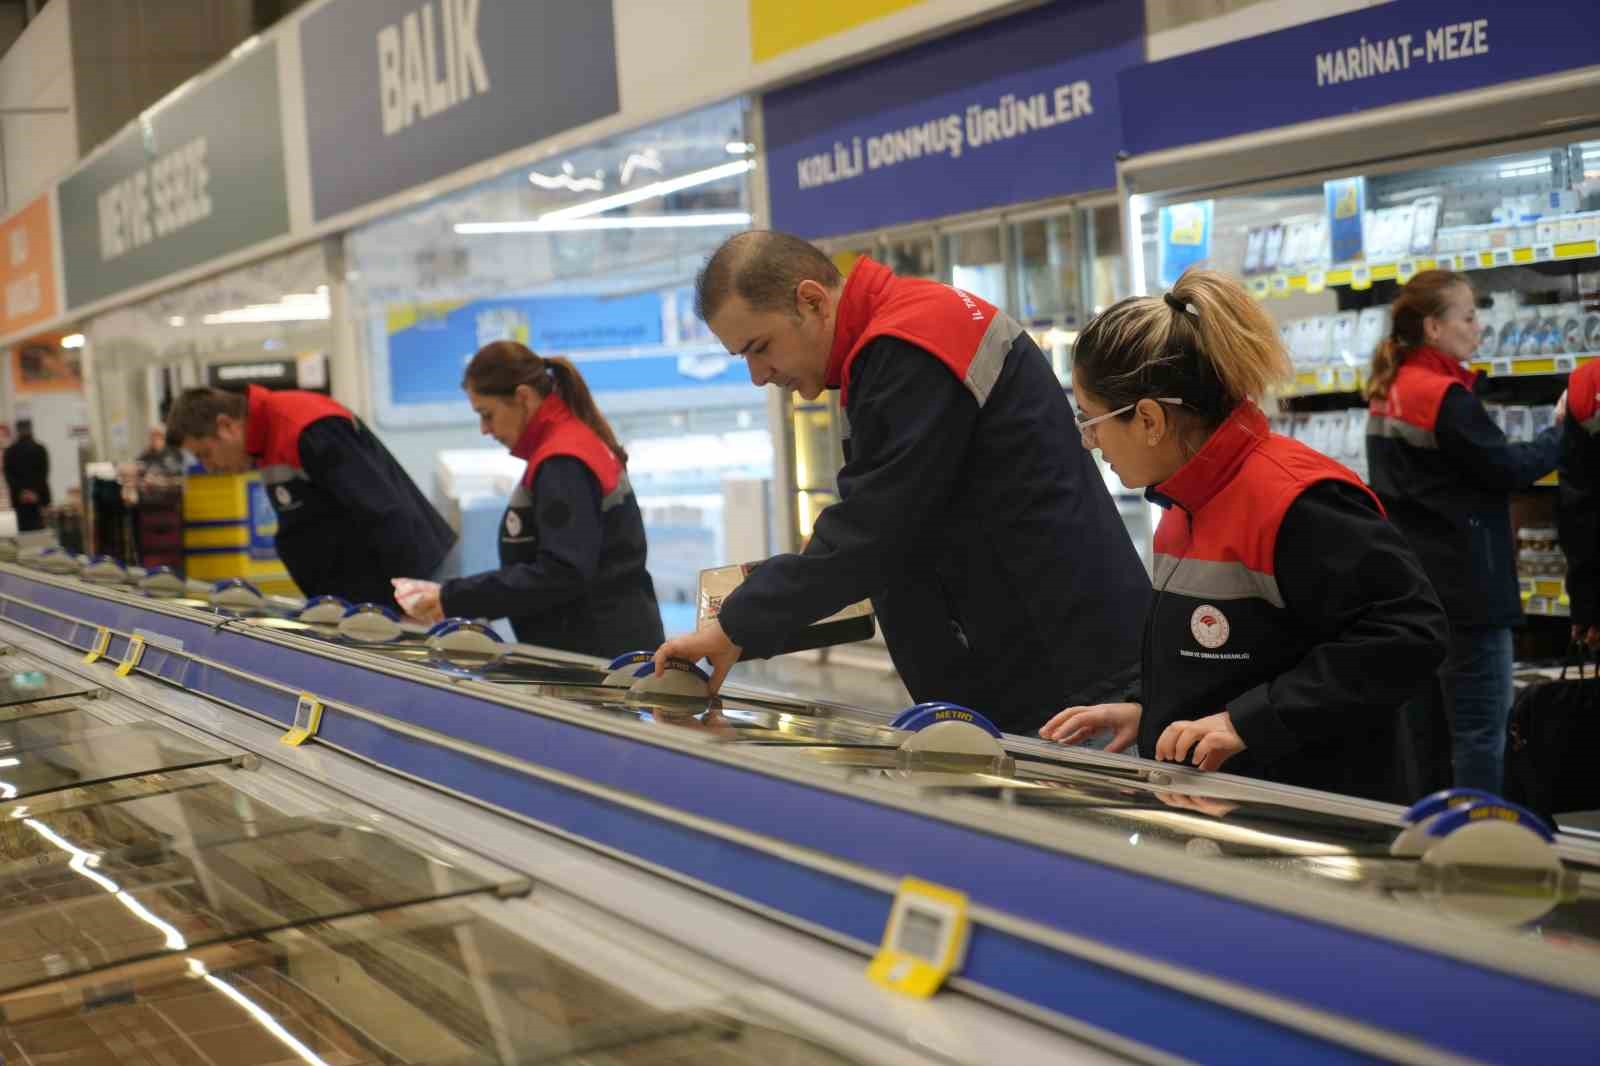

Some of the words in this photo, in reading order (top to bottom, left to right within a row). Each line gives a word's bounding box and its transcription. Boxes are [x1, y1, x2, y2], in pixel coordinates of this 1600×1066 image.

[377, 0, 489, 136] BALIK
[1315, 18, 1489, 87] MARİNAT-MEZE
[797, 137, 863, 190] KOLİLİ
[867, 115, 962, 170] DONMUŞ
[965, 80, 1094, 148] ÜRÜNLER
[936, 710, 972, 721] METRO
